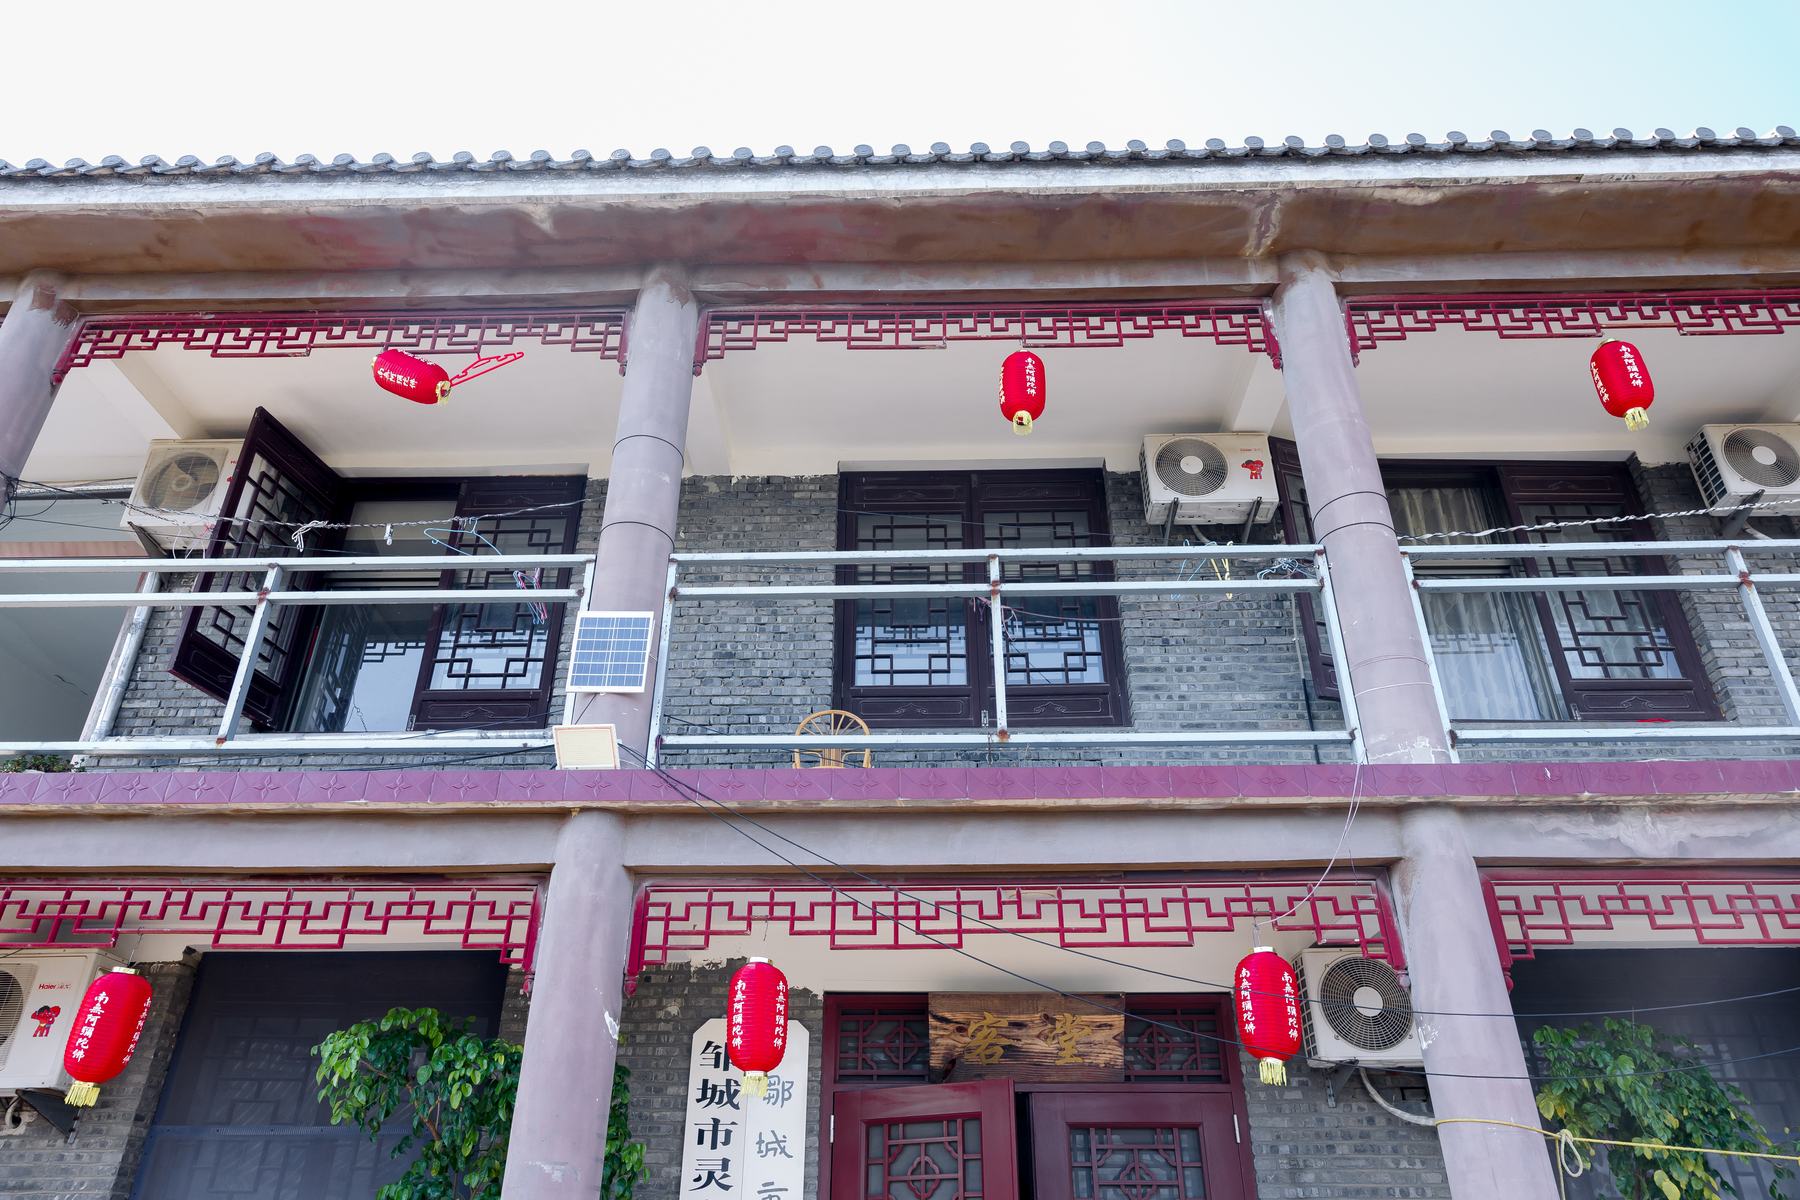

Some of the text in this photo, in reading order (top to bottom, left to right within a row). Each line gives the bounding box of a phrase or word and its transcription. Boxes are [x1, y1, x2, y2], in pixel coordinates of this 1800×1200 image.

[72, 991, 110, 1063] 南無阿彌陀佛
[731, 979, 746, 1051] 南無阿彌陀佛
[1240, 967, 1256, 1036] 南無阿彌陀佛
[1281, 971, 1299, 1042] 南無阿彌陀佛
